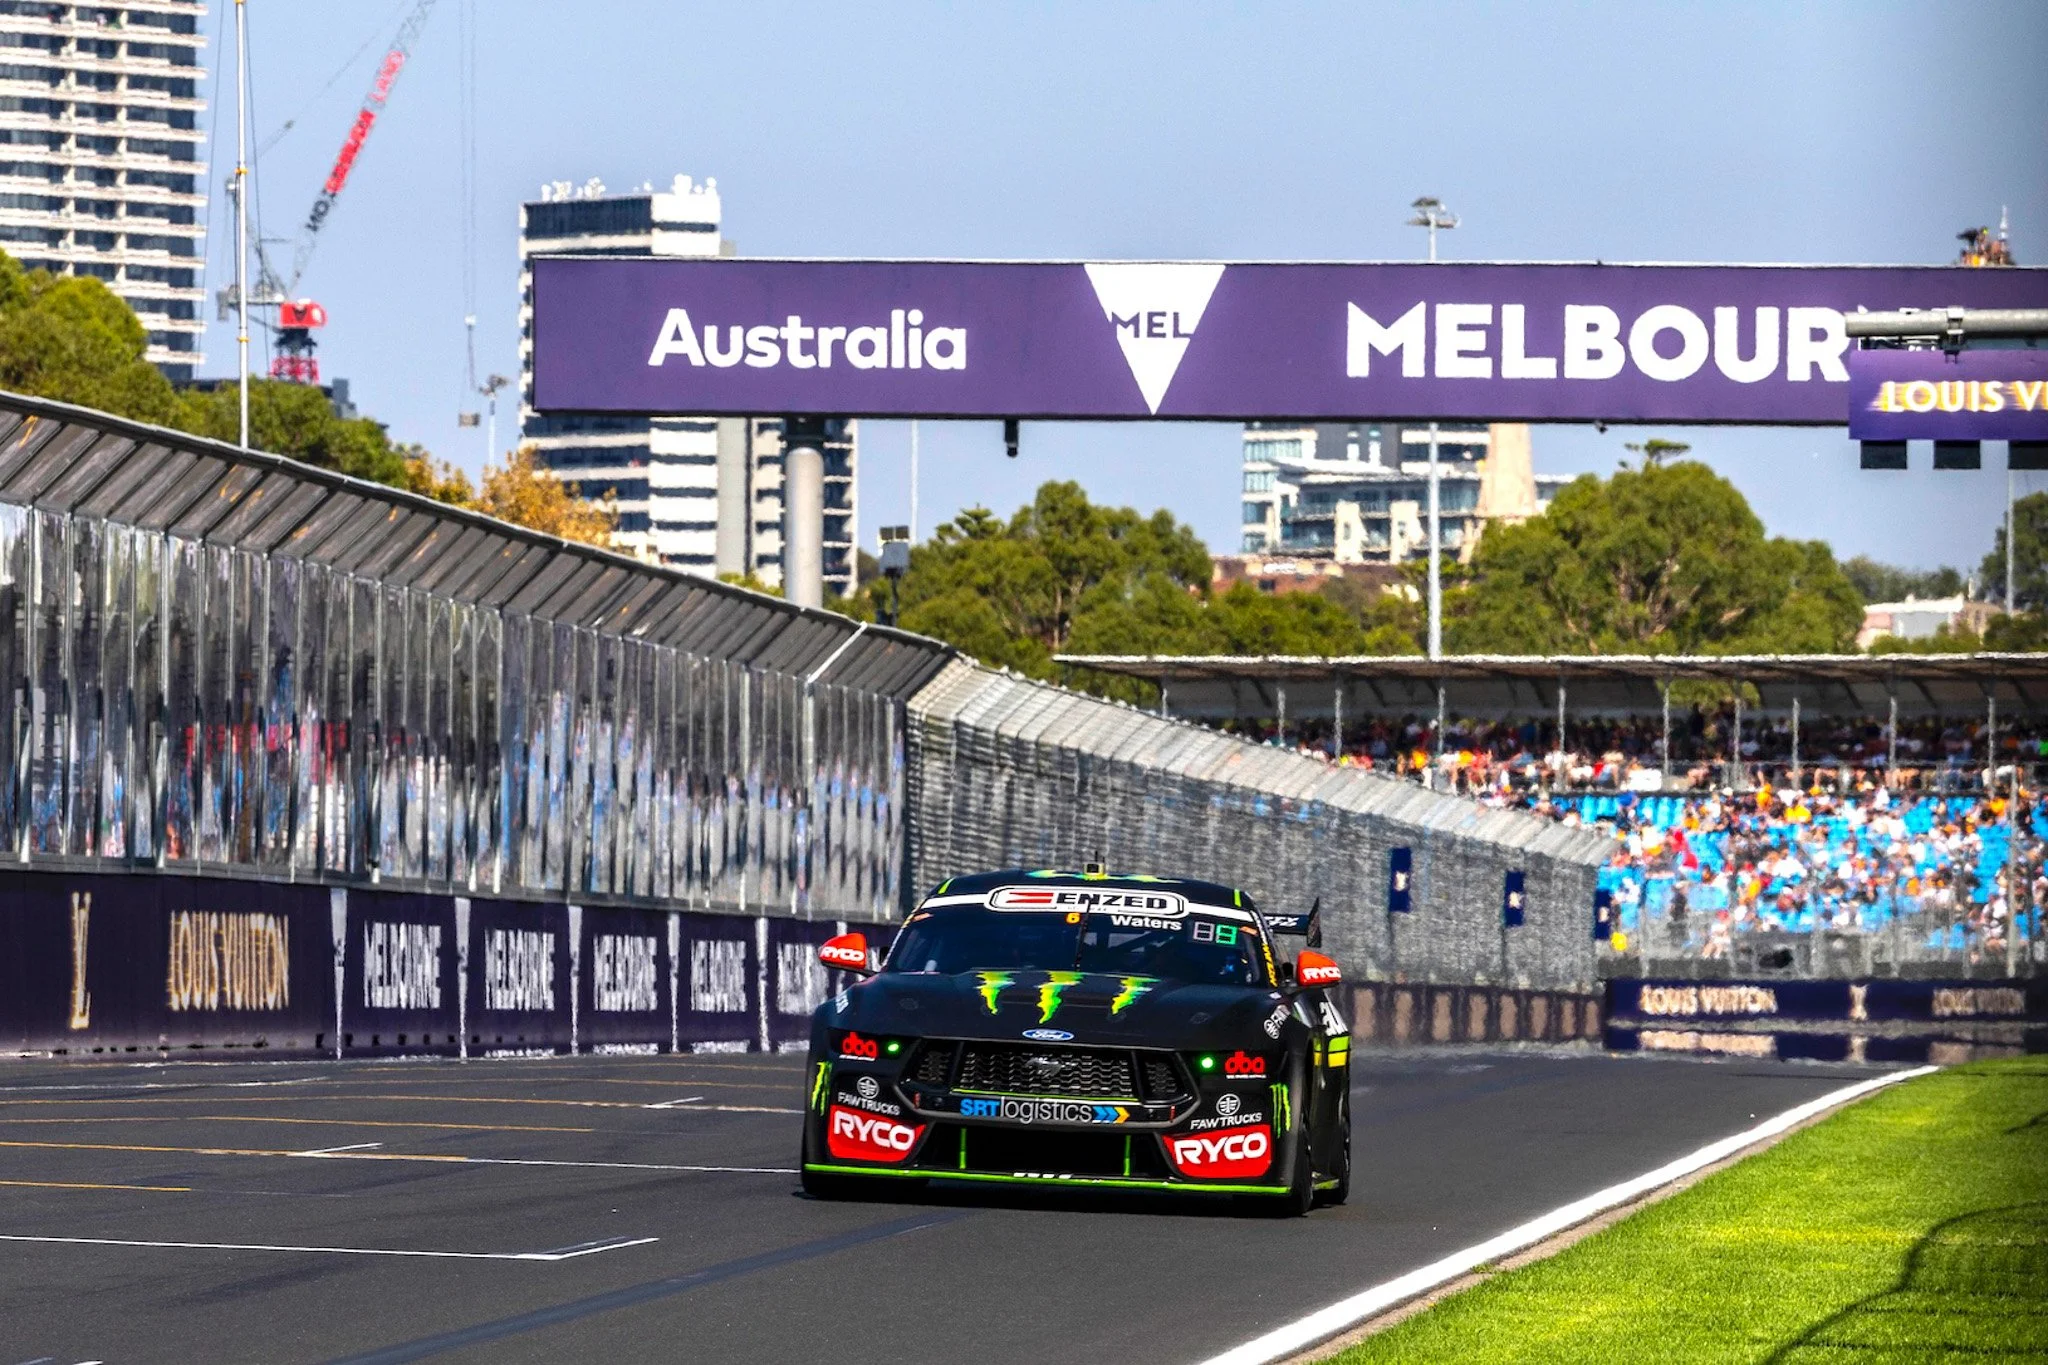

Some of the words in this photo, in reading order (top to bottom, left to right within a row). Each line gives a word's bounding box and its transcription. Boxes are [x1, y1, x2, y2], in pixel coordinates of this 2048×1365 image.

[648, 307, 967, 370] Australia
[1109, 310, 1195, 340] MEL
[1346, 301, 1965, 383] MELBOUR
[1880, 380, 2006, 412] LOUIS
[2014, 380, 2048, 412] V
[1056, 892, 1167, 909] ENZED
[1065, 912, 1081, 924] 6
[1110, 914, 1183, 931] Waters
[167, 910, 219, 1012] LOUIS
[221, 911, 289, 1010] VUITTON
[820, 946, 865, 962] RYCO
[833, 1110, 916, 1151] RYCO
[1173, 1132, 1268, 1165] RYCO
